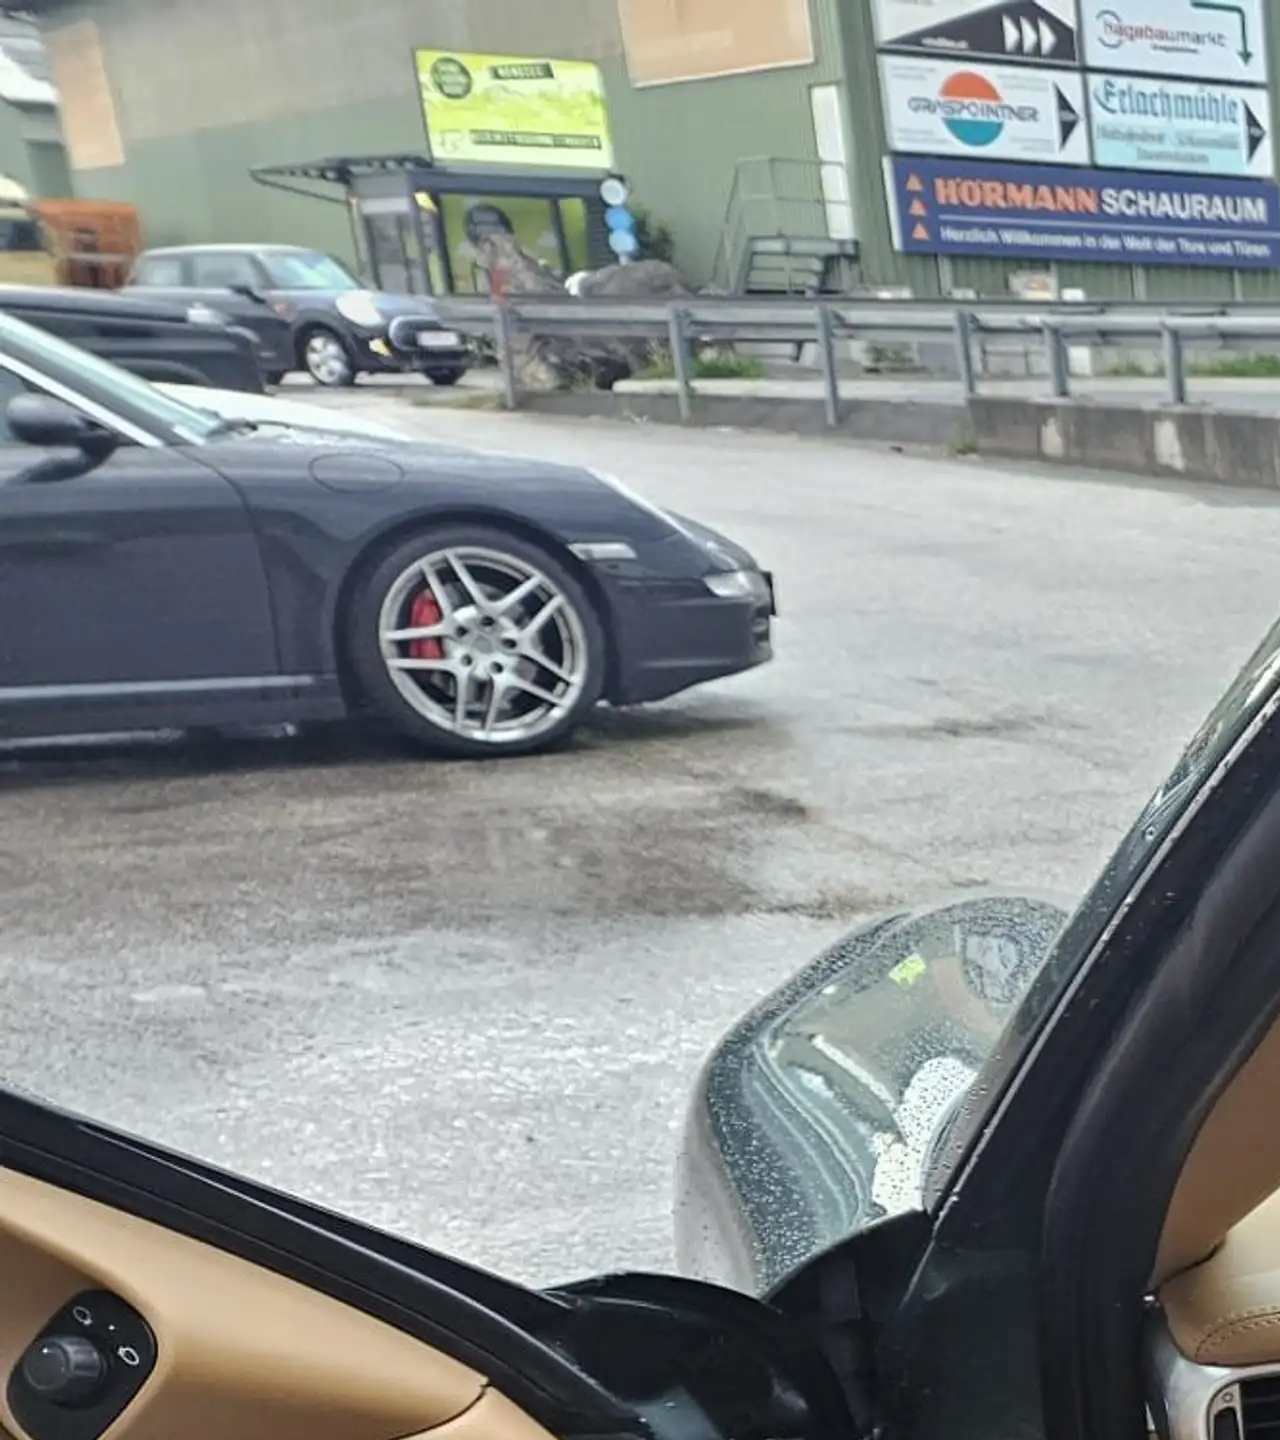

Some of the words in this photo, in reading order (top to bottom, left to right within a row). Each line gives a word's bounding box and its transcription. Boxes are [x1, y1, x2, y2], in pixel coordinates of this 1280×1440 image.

[1093, 80, 1239, 124] Erlachmühle
[1101, 187, 1269, 224] SCHAURAUM
[940, 224, 999, 244] Herzlich
[1000, 227, 1082, 249] Willkommen
